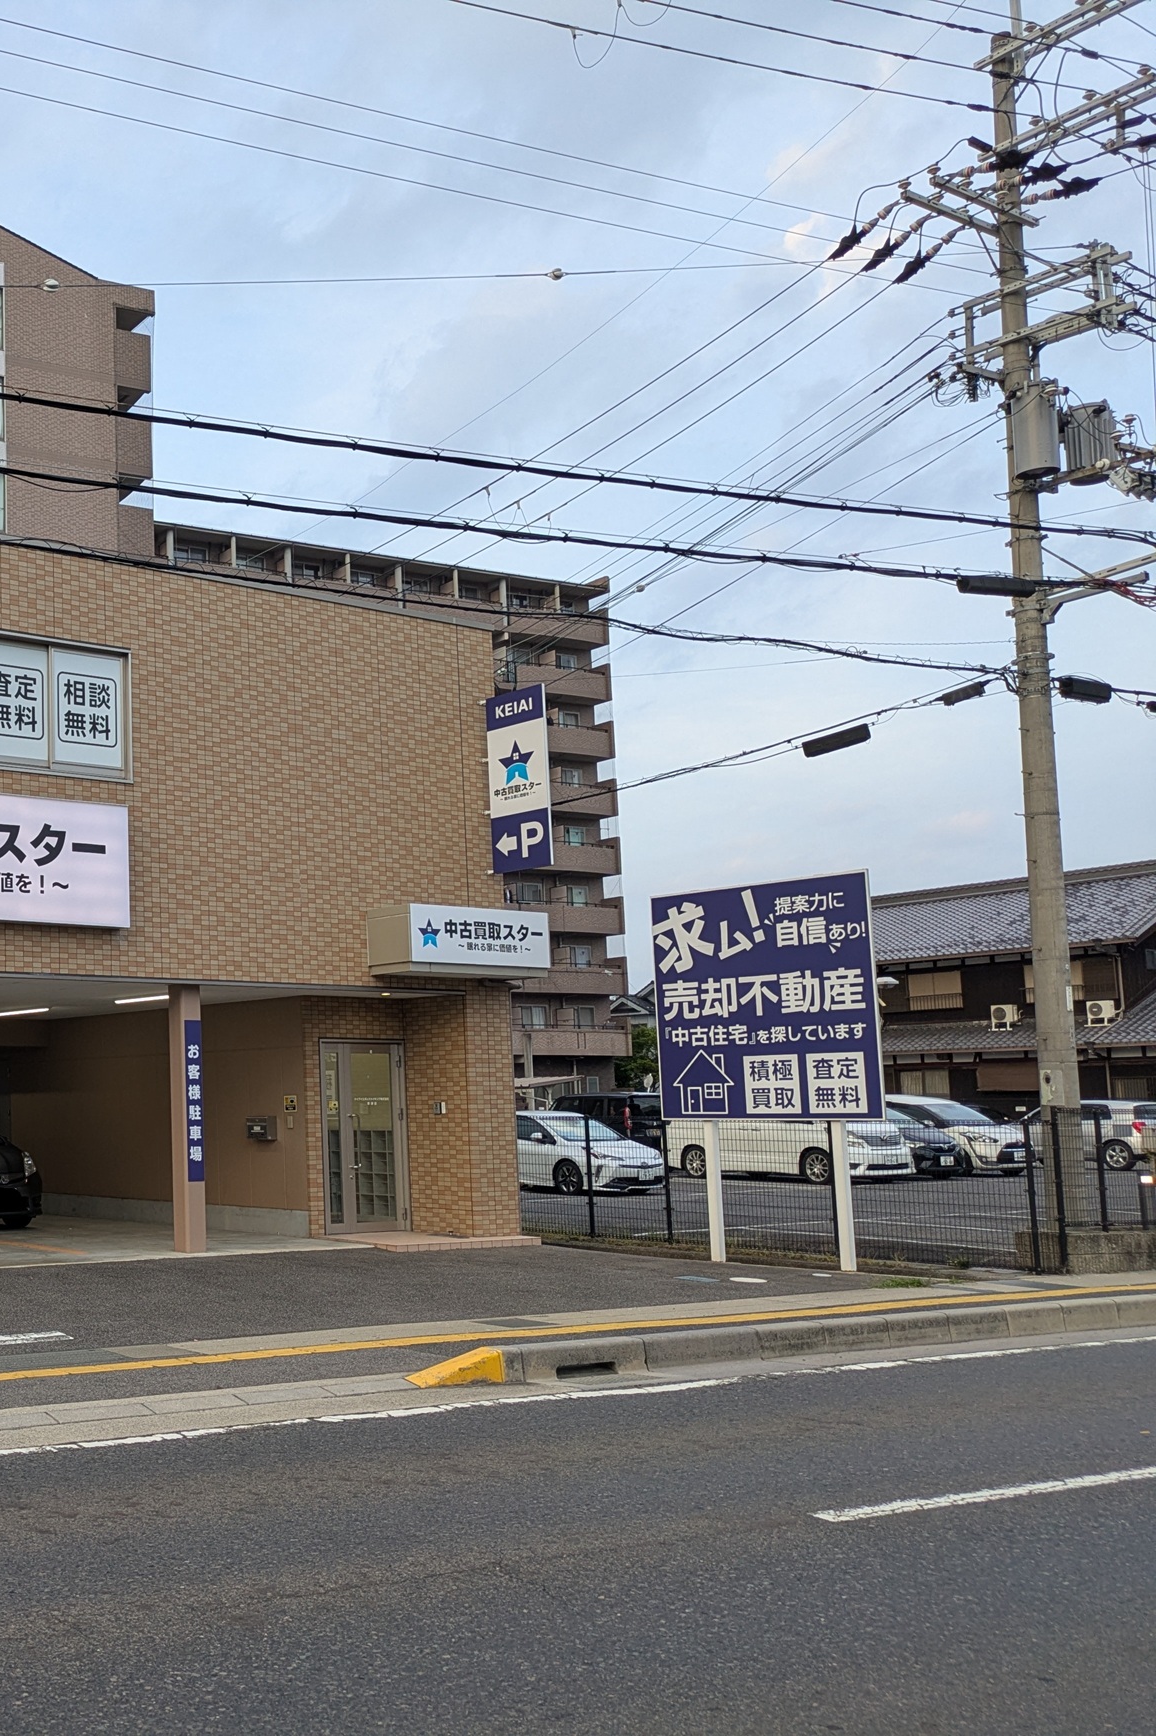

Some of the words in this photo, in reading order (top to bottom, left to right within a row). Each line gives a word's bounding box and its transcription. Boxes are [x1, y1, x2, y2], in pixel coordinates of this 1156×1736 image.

[64, 679, 111, 710] 相談
[495, 697, 533, 719] KEIAI
[64, 710, 111, 740] 無料
[494, 782, 542, 798] 中古買取スター
[520, 820, 544, 859] P
[775, 892, 845, 915] 提案力に
[444, 919, 543, 942] 中古買取スター
[775, 916, 866, 947] 自信あり!
[662, 967, 866, 1021] 売却不動産
[749, 1059, 793, 1082] 積極
[812, 1057, 859, 1080] 査定
[187, 1045, 202, 1162] お客様駐車場
[751, 1087, 796, 1109] 買取
[814, 1086, 861, 1109] 無料
